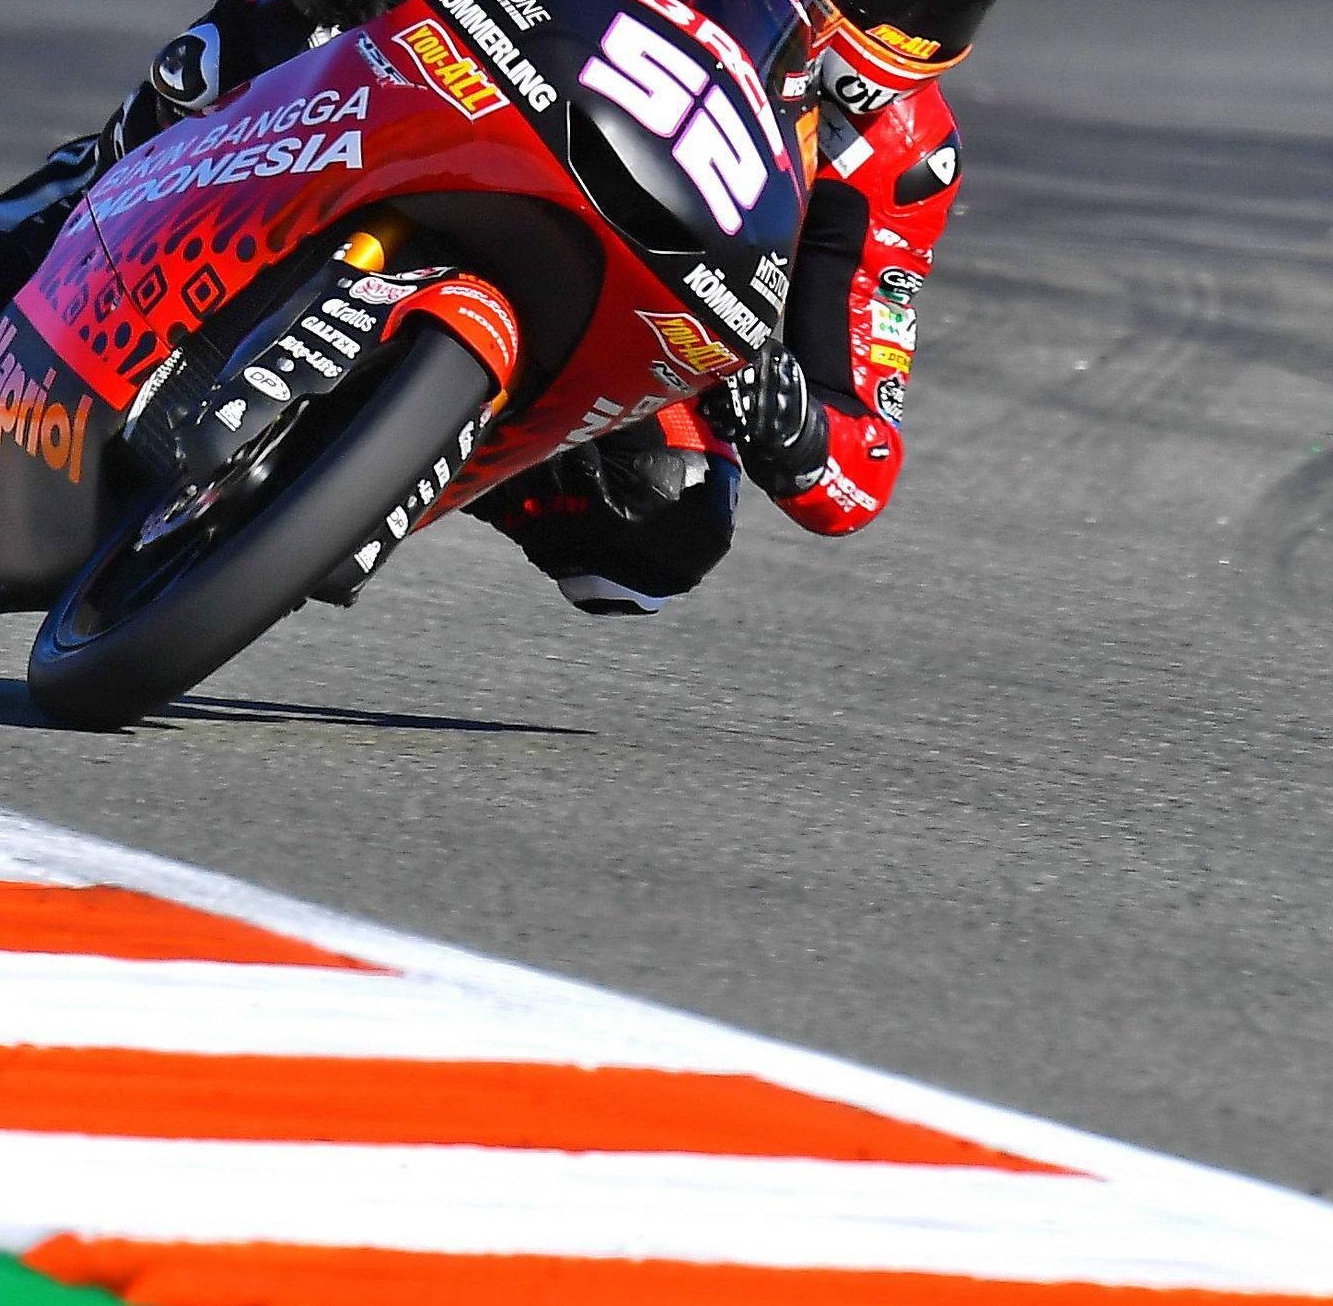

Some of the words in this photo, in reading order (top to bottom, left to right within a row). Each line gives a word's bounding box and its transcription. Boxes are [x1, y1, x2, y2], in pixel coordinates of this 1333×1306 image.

[406, 24, 498, 112] YOU-ALL
[190, 86, 370, 156] BANGGA
[579, 11, 770, 235] 52
[66, 130, 364, 237] INDONESIA
